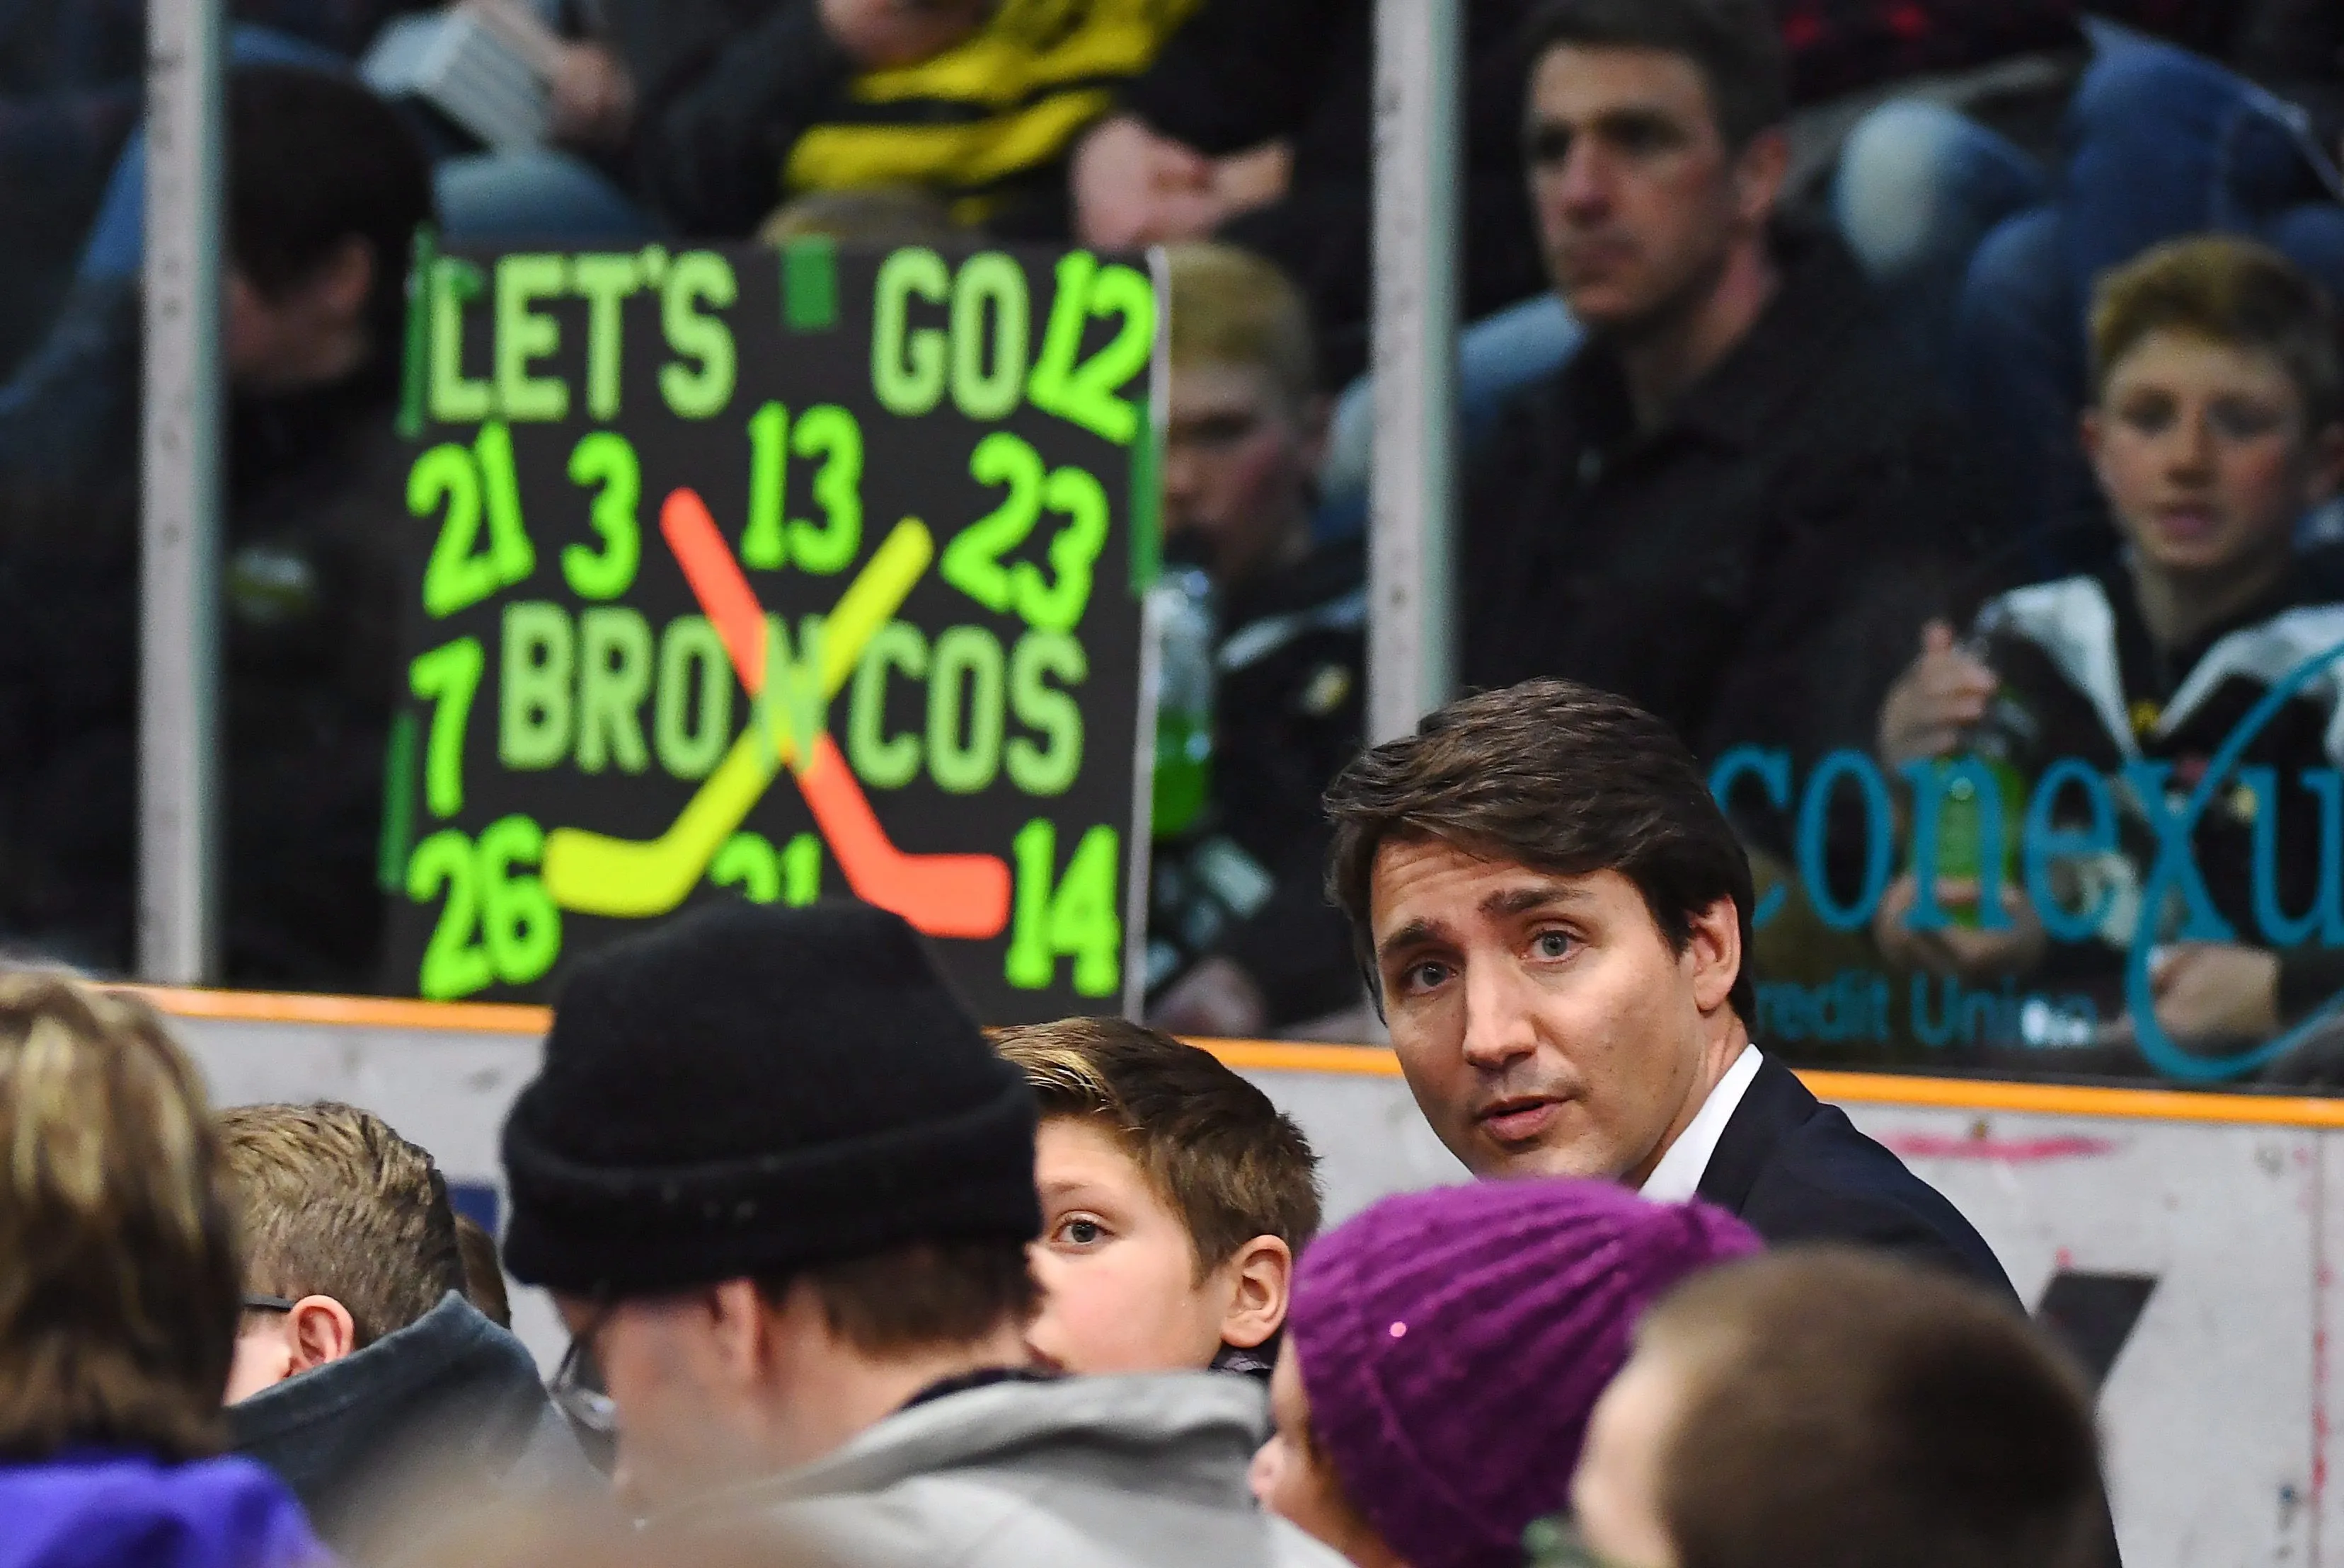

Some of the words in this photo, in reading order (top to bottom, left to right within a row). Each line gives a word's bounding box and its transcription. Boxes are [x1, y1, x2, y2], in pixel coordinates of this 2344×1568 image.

[429, 244, 737, 420] LET'S
[871, 246, 1030, 419] GO
[1026, 249, 1159, 444] 12
[406, 419, 535, 617] 21
[561, 431, 641, 599] 3
[740, 400, 864, 575] 13
[940, 432, 1110, 632] 23
[408, 637, 484, 817] 7
[498, 600, 1088, 796] BRONCOS
[406, 814, 563, 1000] 26
[1005, 818, 1121, 996] 14
[1754, 969, 1890, 1041] redit
